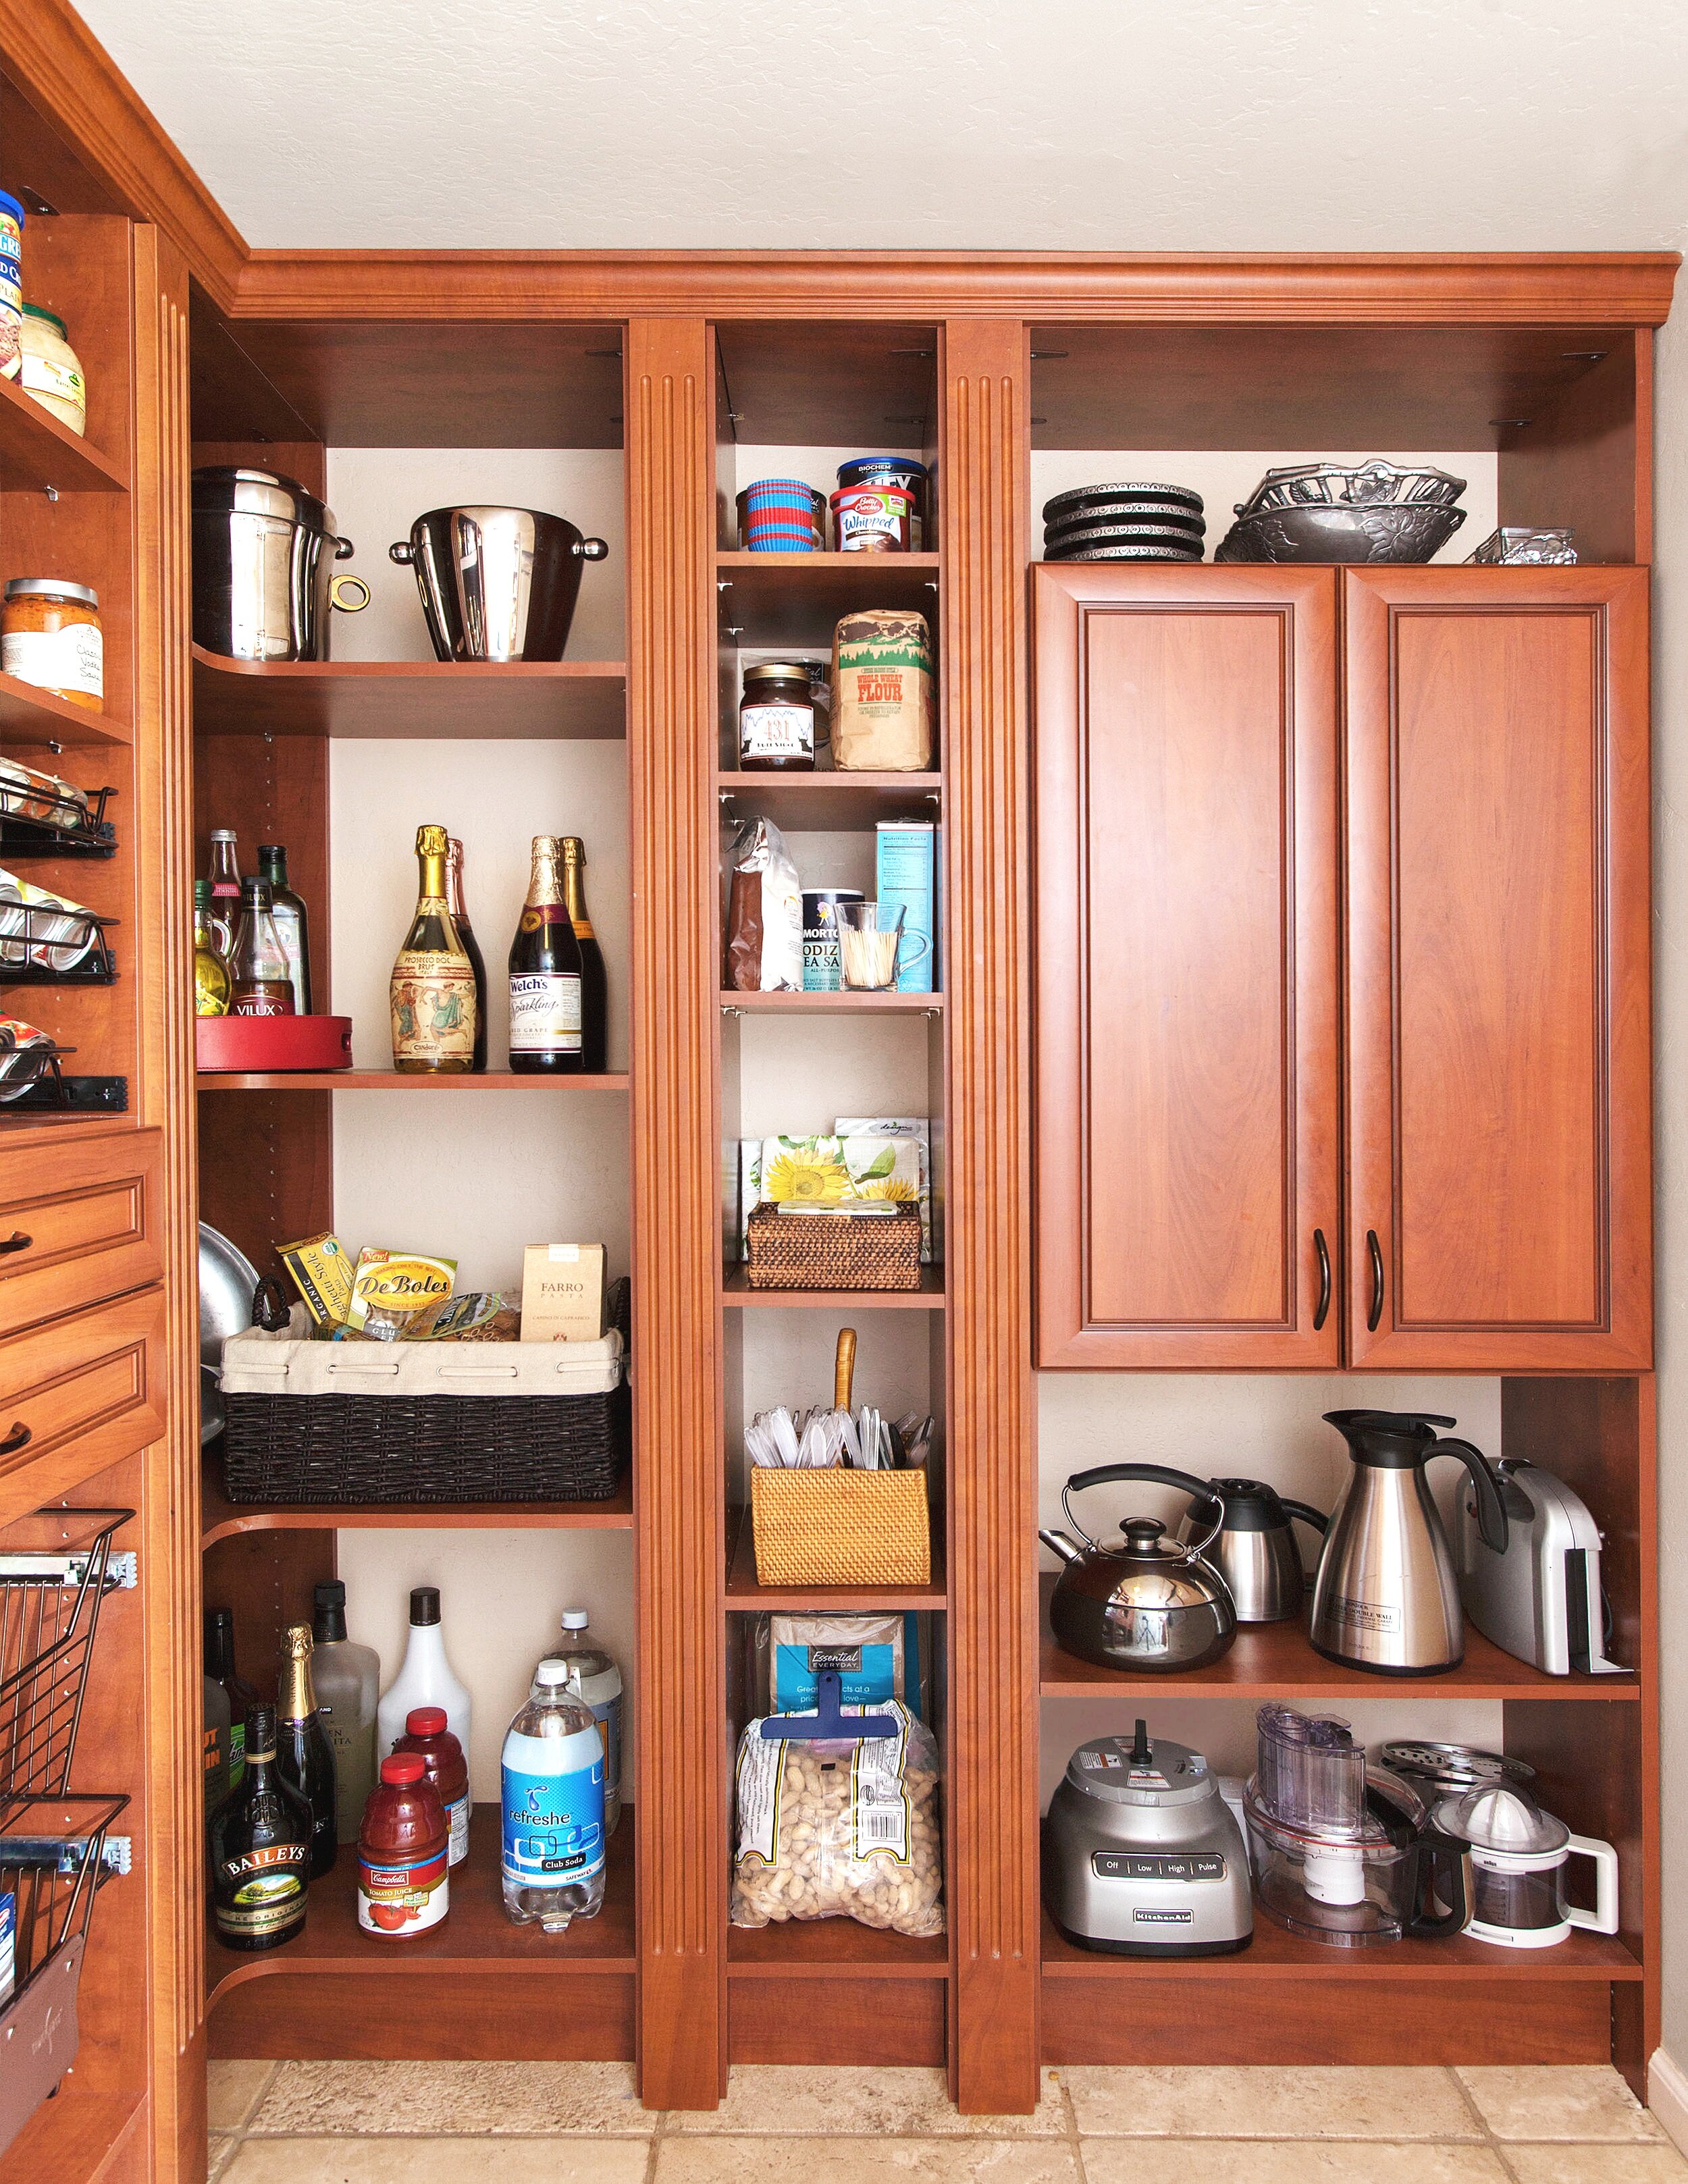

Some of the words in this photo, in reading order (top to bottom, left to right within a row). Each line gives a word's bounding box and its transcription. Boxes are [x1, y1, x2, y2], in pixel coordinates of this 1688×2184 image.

[860, 497, 877, 506] Betty
[845, 516, 895, 531] Whipped
[857, 674, 879, 683] WHOLE
[880, 674, 903, 683] WHEAT
[858, 683, 903, 702] FLOUR
[764, 720, 789, 741] 431
[405, 956, 434, 964] PROSECCO
[511, 978, 548, 993] Welch's
[237, 1005, 275, 1016] VILUX
[510, 995, 559, 1023] Sparkling
[364, 1251, 388, 1262] New!
[358, 1276, 390, 1295] De
[391, 1275, 448, 1294] Boles
[542, 1283, 583, 1292] FARRO
[1350, 1609, 1373, 1618] DOUBLE
[812, 1650, 858, 1662] Essential
[289, 1662, 297, 1705] CHANDON
[510, 1810, 571, 1826] refreshe
[227, 1846, 306, 1875] BAILEYS
[545, 1861, 564, 1869] Club
[565, 1856, 583, 1866] Soda
[1106, 1861, 1119, 1869] Off
[1137, 1864, 1152, 1872] Low
[1168, 1865, 1185, 1873] High
[566, 1872, 586, 1881] SAFEWAY
[369, 1888, 393, 1896] TOMATO
[394, 1887, 413, 1896] JUICE
[1136, 1913, 1191, 1921] KitchenAid
